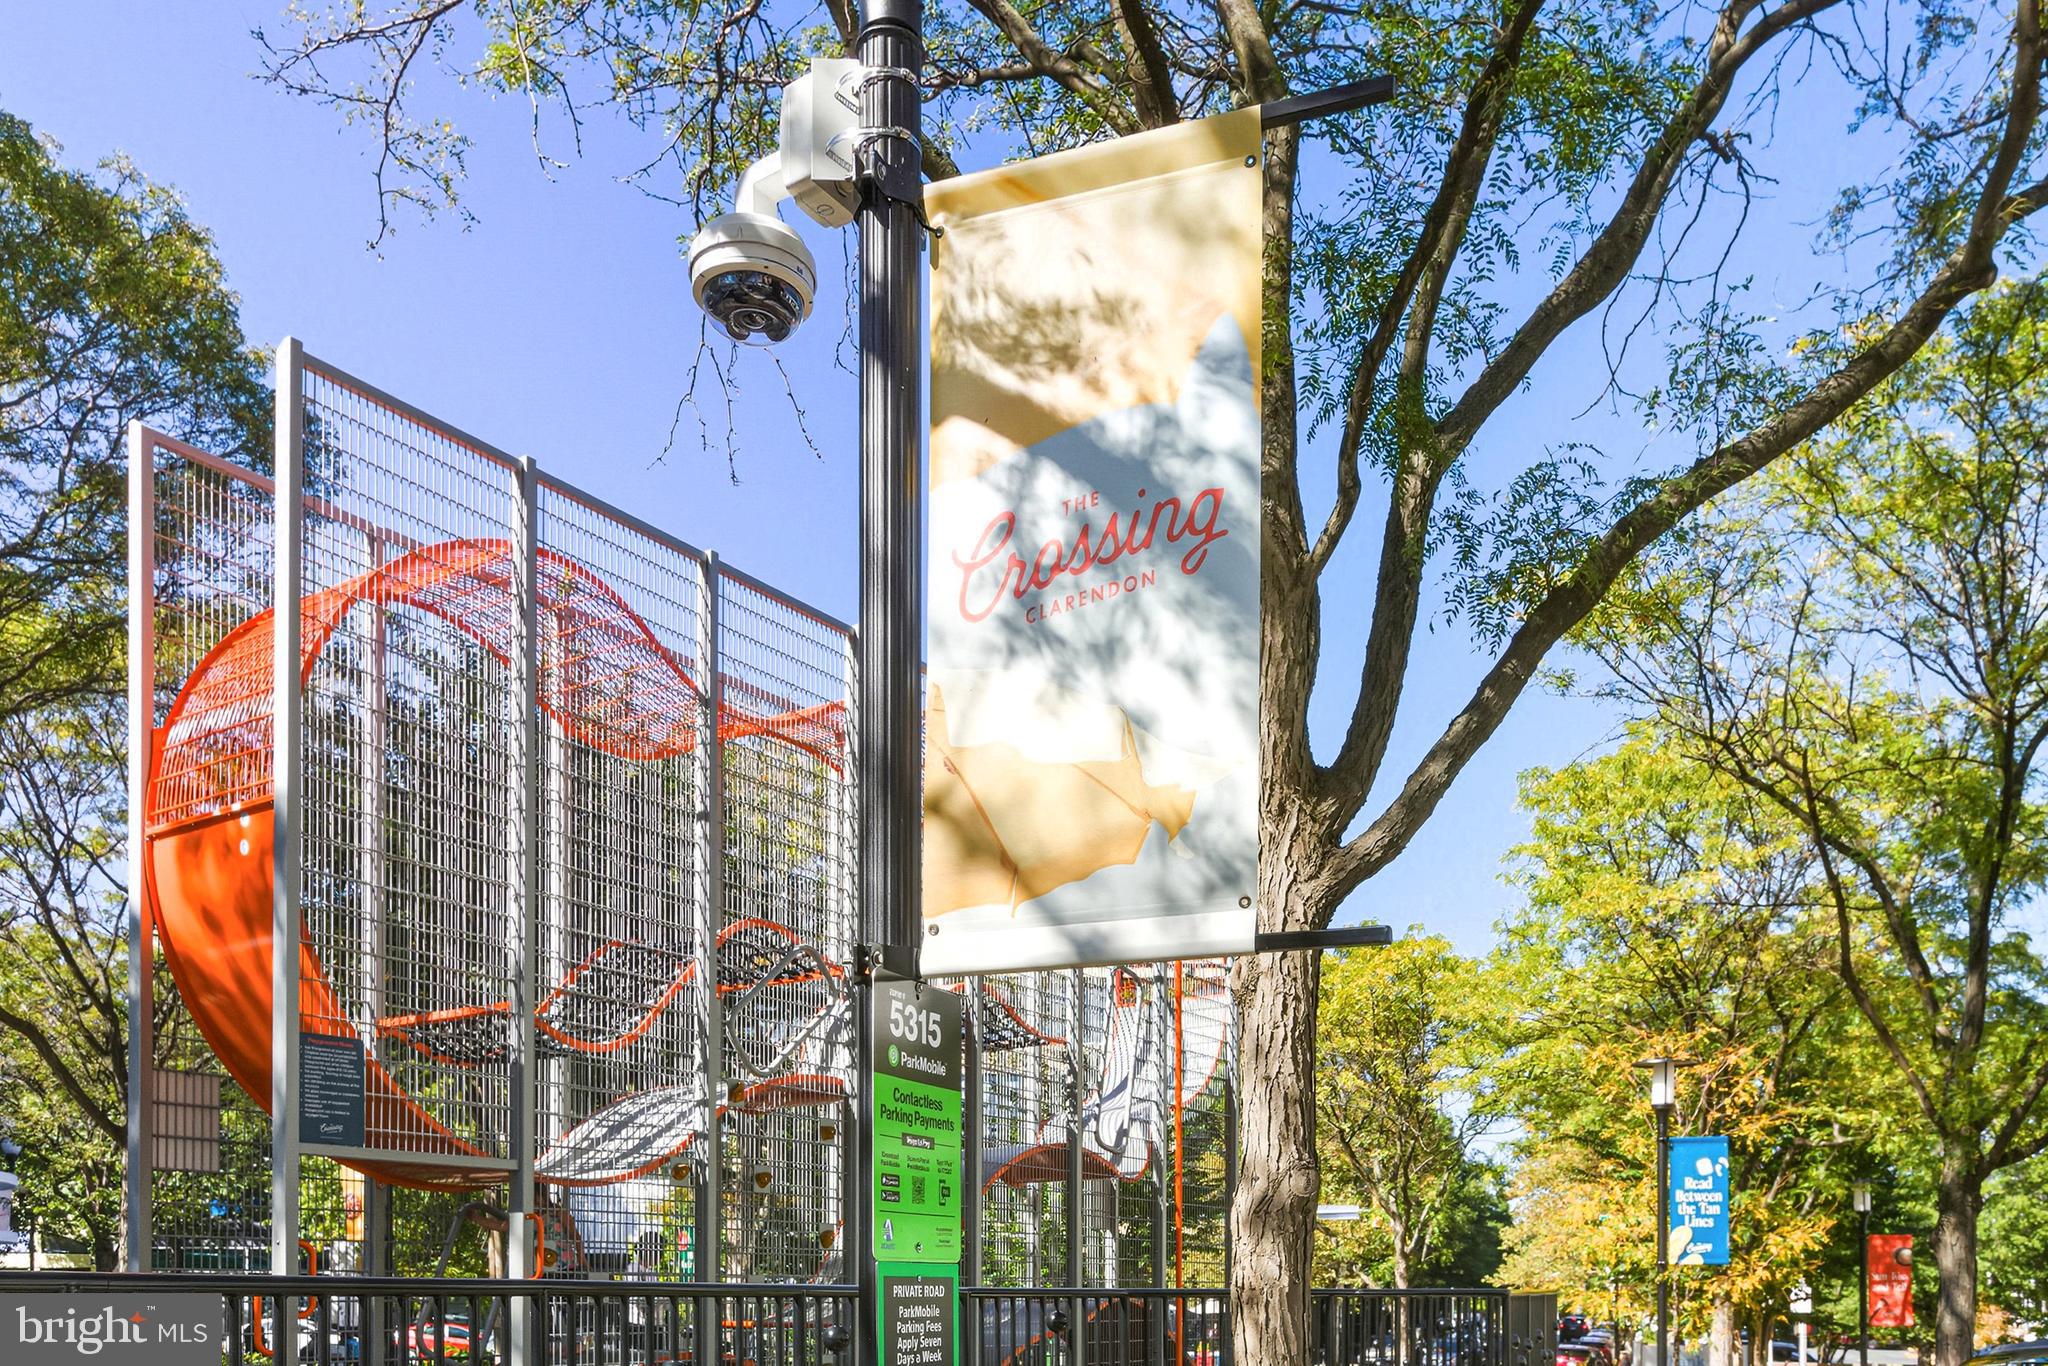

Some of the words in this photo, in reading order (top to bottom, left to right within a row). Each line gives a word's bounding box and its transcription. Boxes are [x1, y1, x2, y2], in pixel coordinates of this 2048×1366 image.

[1062, 490, 1100, 517] THE
[952, 487, 1229, 623] Crossing
[1025, 569, 1157, 625] CLARENDON
[889, 1000, 942, 1048] 5315
[901, 1051, 947, 1076] ParkMobile
[893, 1087, 943, 1112] Contactless
[880, 1103, 913, 1127] Parking
[914, 1111, 955, 1132] Payments
[1684, 1176, 1713, 1190] Read
[1675, 1189, 1723, 1203] Between
[1677, 1202, 1696, 1215] the
[1697, 1202, 1721, 1215] Tan
[1684, 1214, 1715, 1228] Lines
[893, 1285, 923, 1298] PRIVATE
[923, 1285, 945, 1297] ROAD
[898, 1304, 940, 1318] ParkMobile
[896, 1320, 925, 1335] Parking
[925, 1320, 942, 1332] Fees
[897, 1335, 919, 1352] Apply
[919, 1335, 942, 1348] Seven
[897, 1352, 915, 1366] Days
[915, 1354, 921, 1363] a
[921, 1349, 942, 1363] Week
